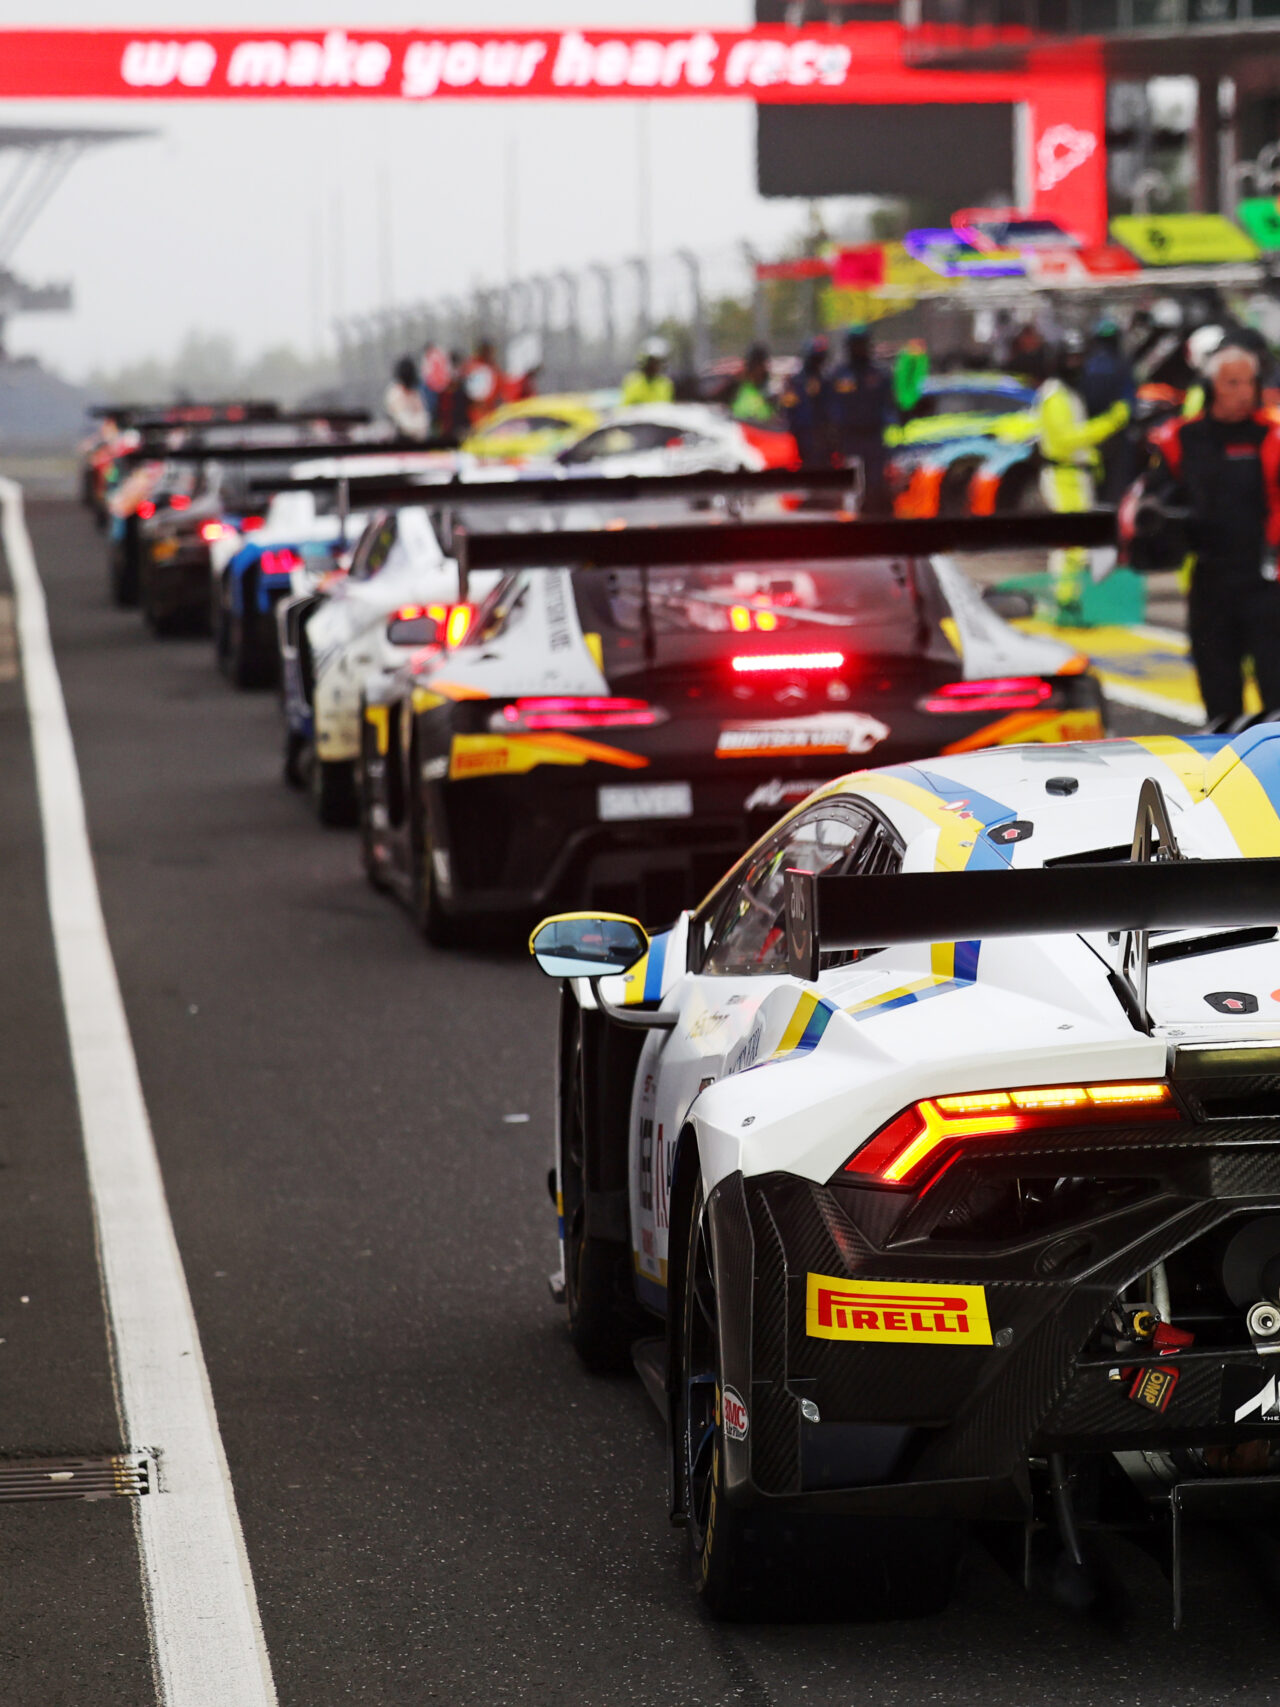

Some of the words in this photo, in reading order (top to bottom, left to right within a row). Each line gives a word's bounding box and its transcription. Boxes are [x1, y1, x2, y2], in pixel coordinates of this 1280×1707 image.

[121, 40, 217, 86] we
[227, 30, 391, 86] make
[401, 40, 547, 97] your
[552, 32, 719, 86] heart
[818, 1288, 970, 1333] PIRELLI
[1143, 1372, 1164, 1404] OMP
